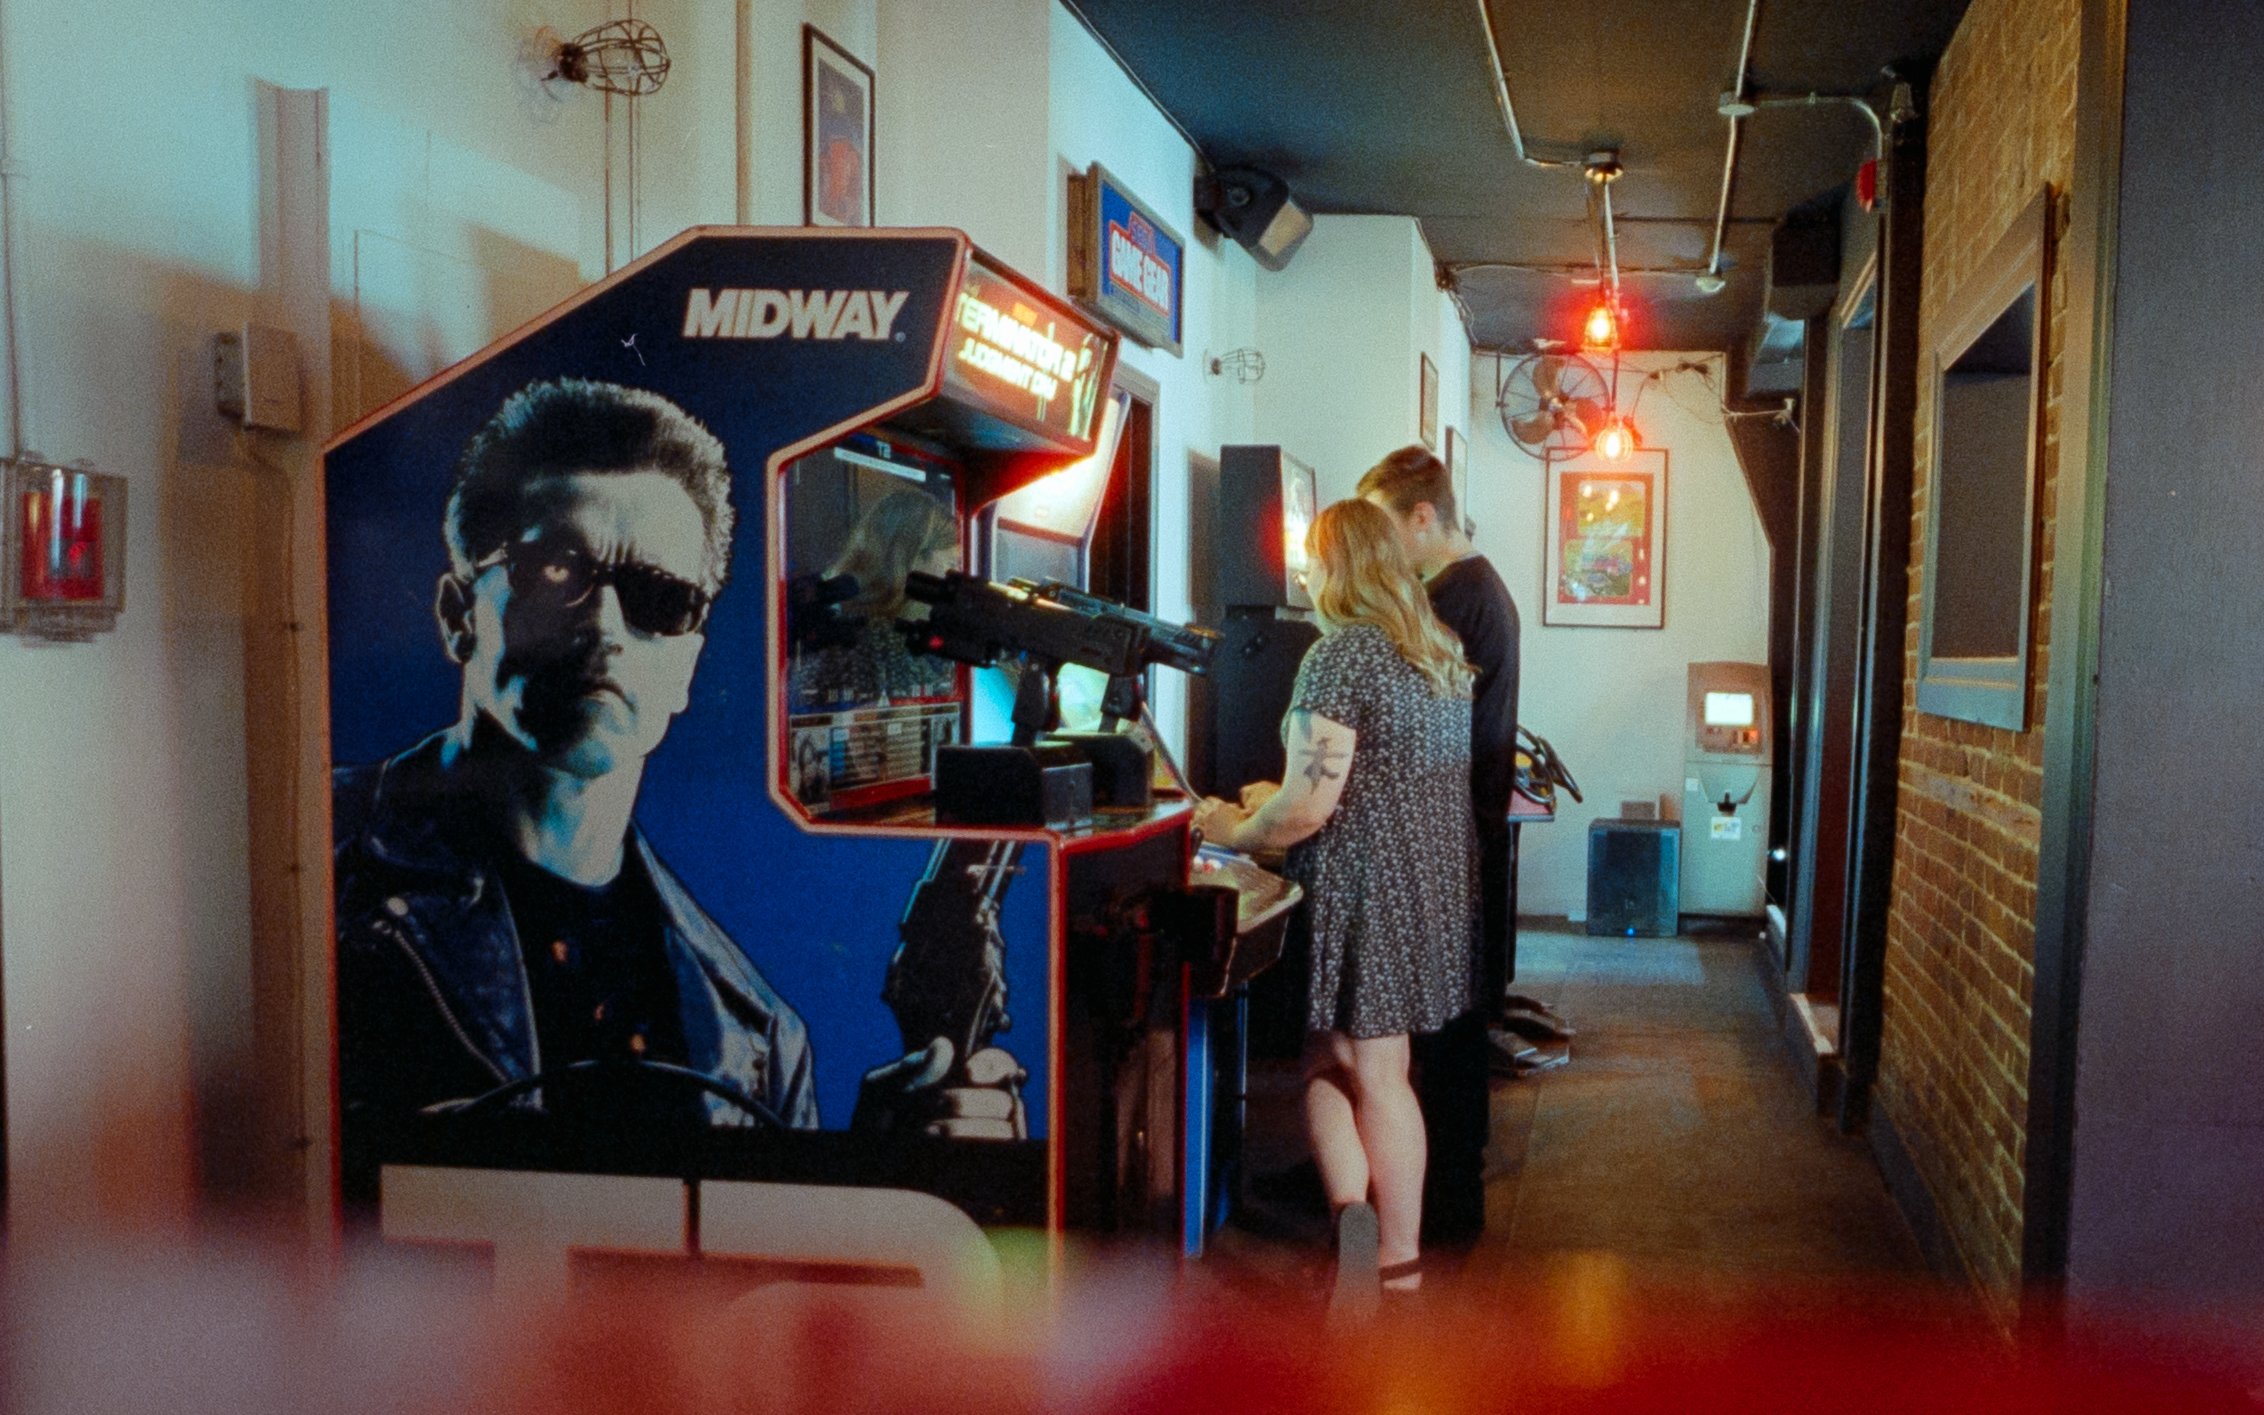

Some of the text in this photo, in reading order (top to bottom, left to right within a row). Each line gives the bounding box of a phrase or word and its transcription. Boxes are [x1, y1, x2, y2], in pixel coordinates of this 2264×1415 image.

[1112, 229, 1143, 293] GAME
[1143, 254, 1169, 311] GEAR
[682, 287, 910, 341] MIDWAY
